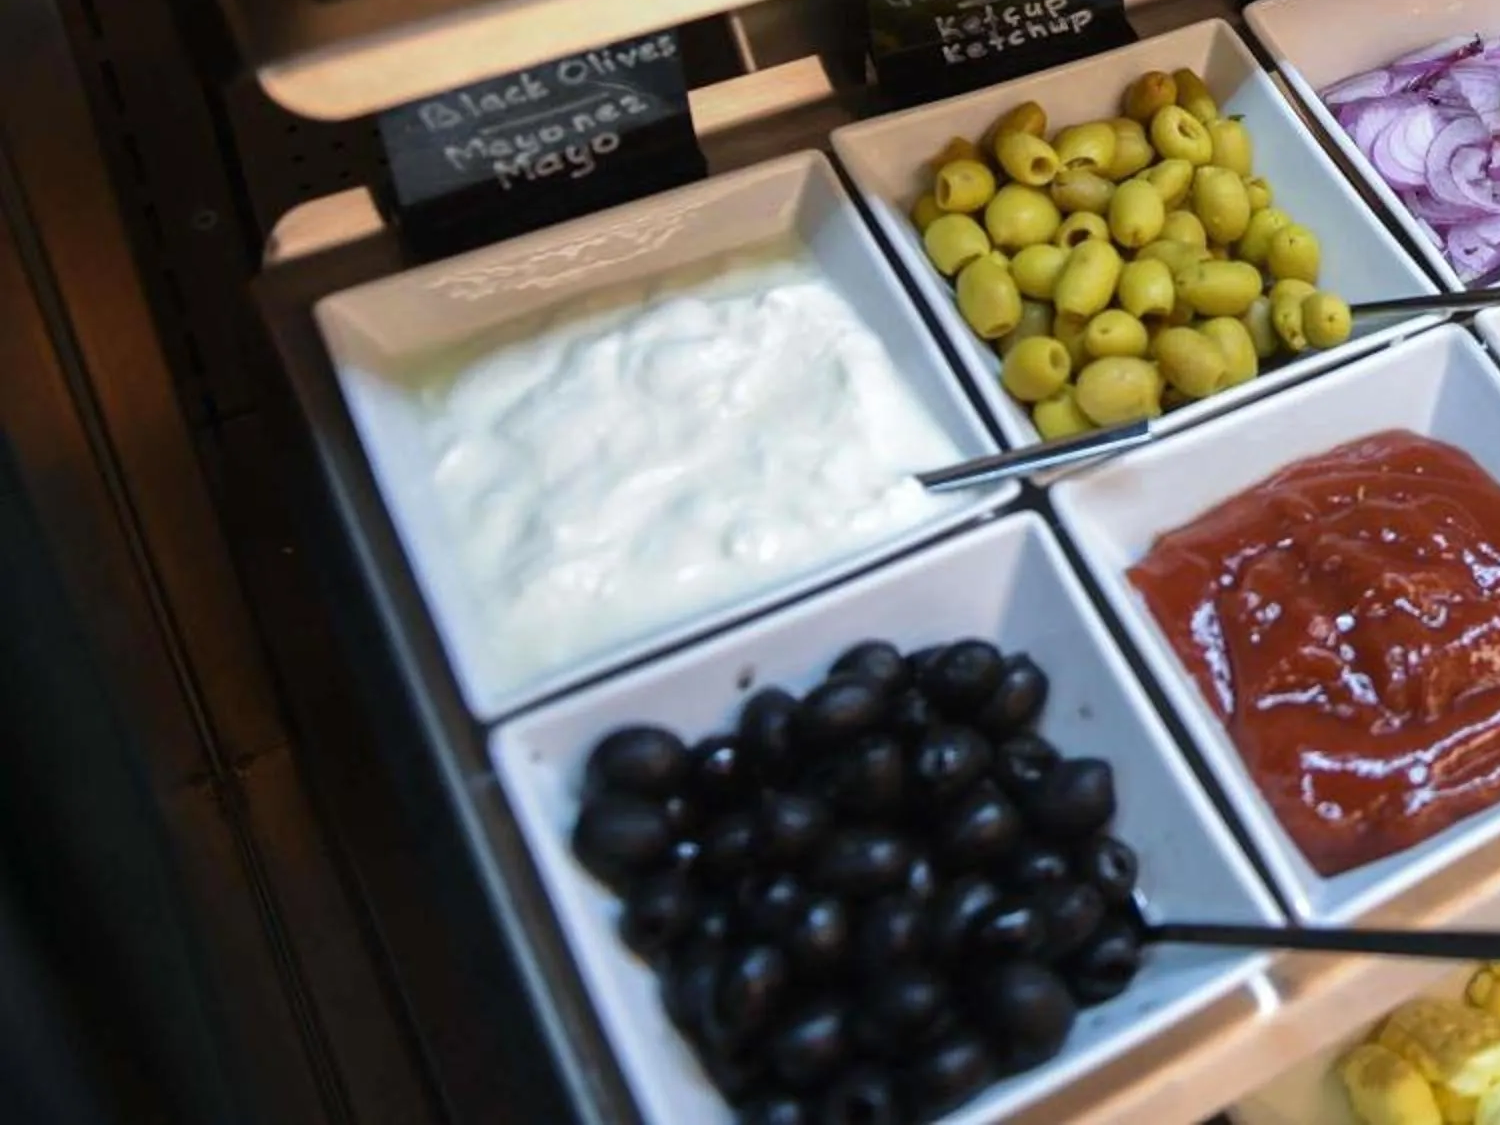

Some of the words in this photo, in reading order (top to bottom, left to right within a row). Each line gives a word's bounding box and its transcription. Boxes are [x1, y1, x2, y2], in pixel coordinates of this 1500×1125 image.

[941, 8, 1094, 65] Ketchup
[418, 73, 549, 132] Black
[556, 34, 678, 84] Olives
[493, 132, 620, 190] Mayo
